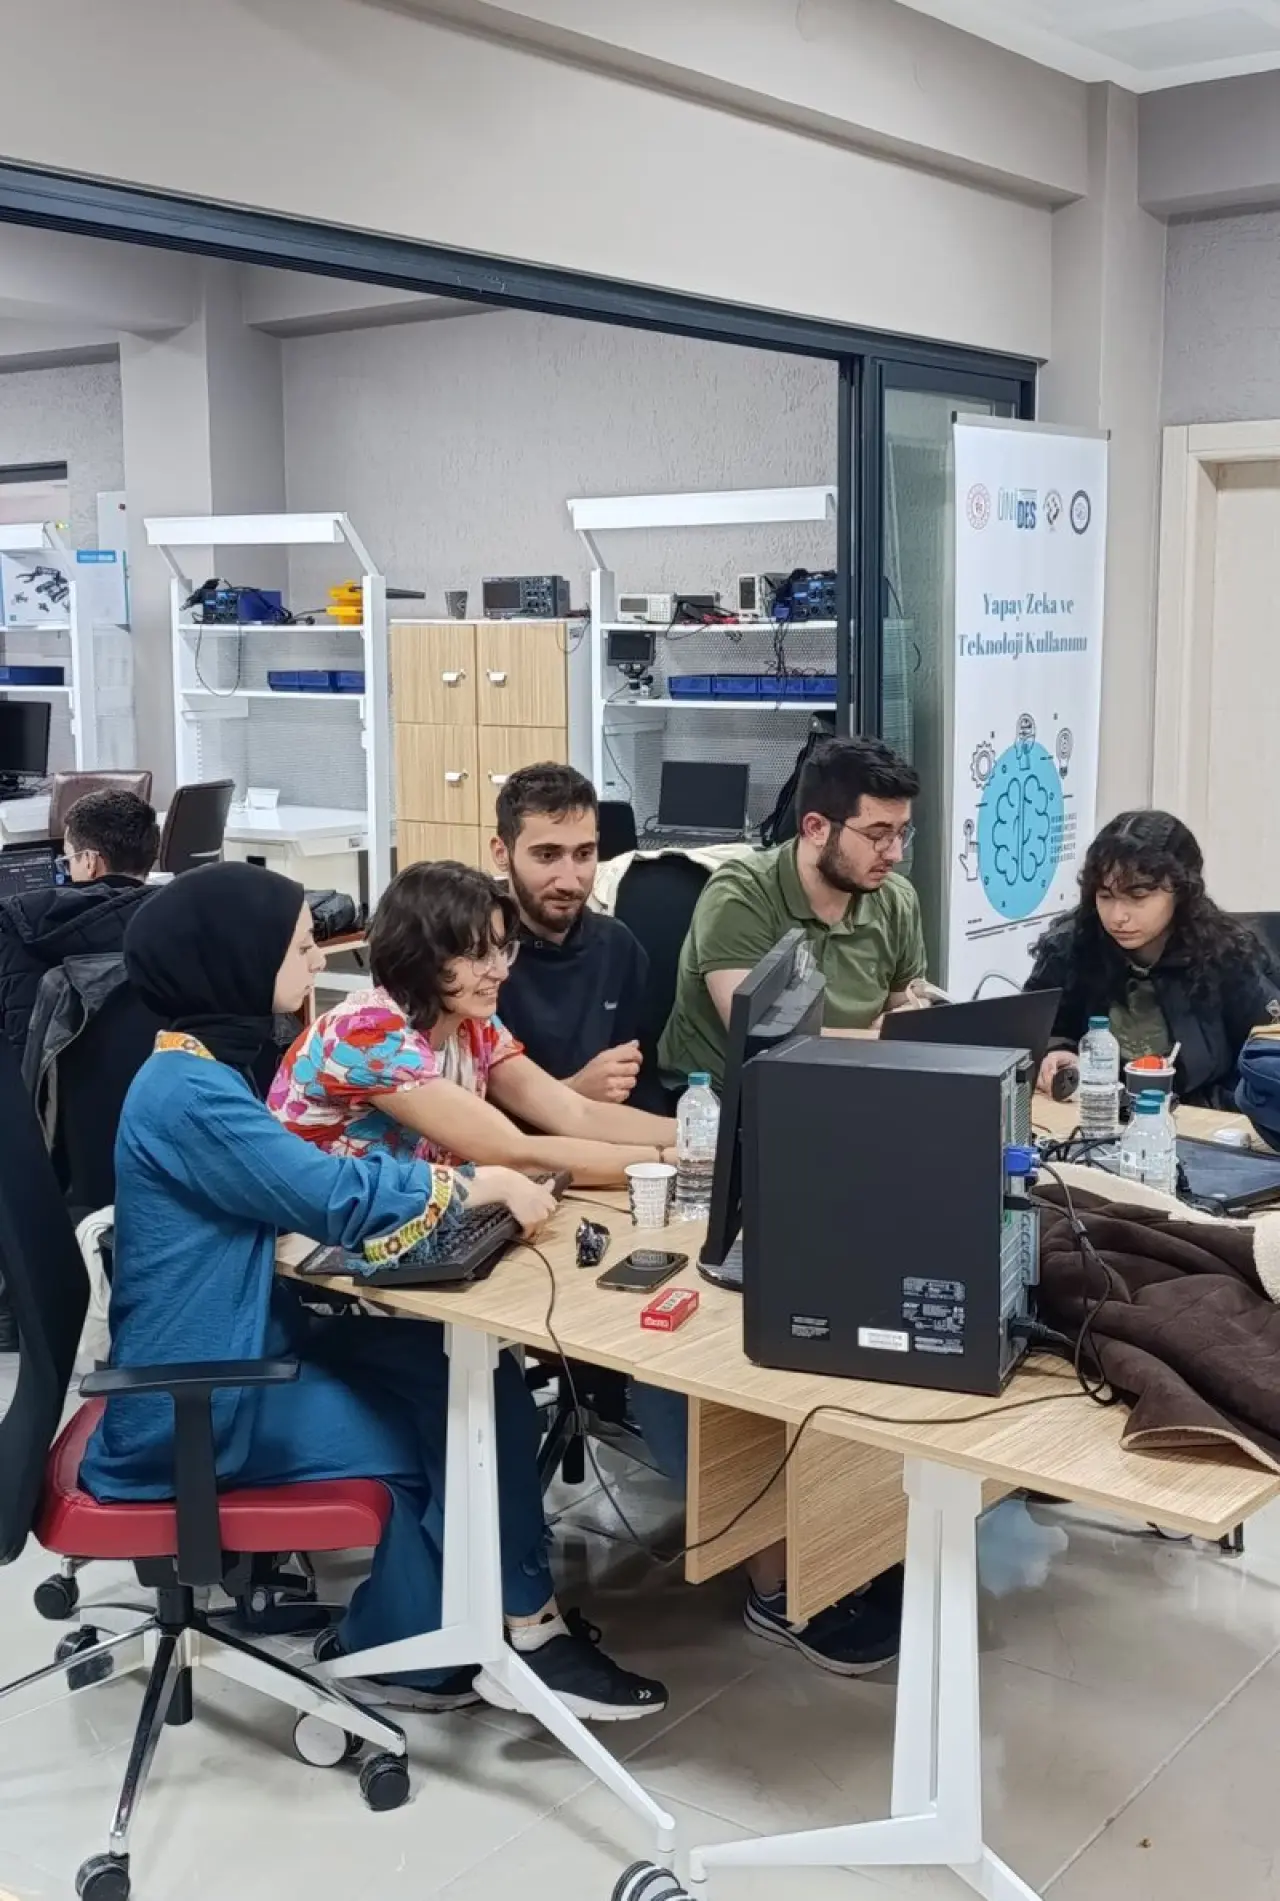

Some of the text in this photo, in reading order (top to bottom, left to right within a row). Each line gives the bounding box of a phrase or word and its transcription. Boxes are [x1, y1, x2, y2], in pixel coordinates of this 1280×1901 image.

[1016, 500, 1037, 529] DES
[983, 592, 1074, 621] Yapay Zeka ve
[959, 630, 1087, 660] Teknoloji Kullanımı
